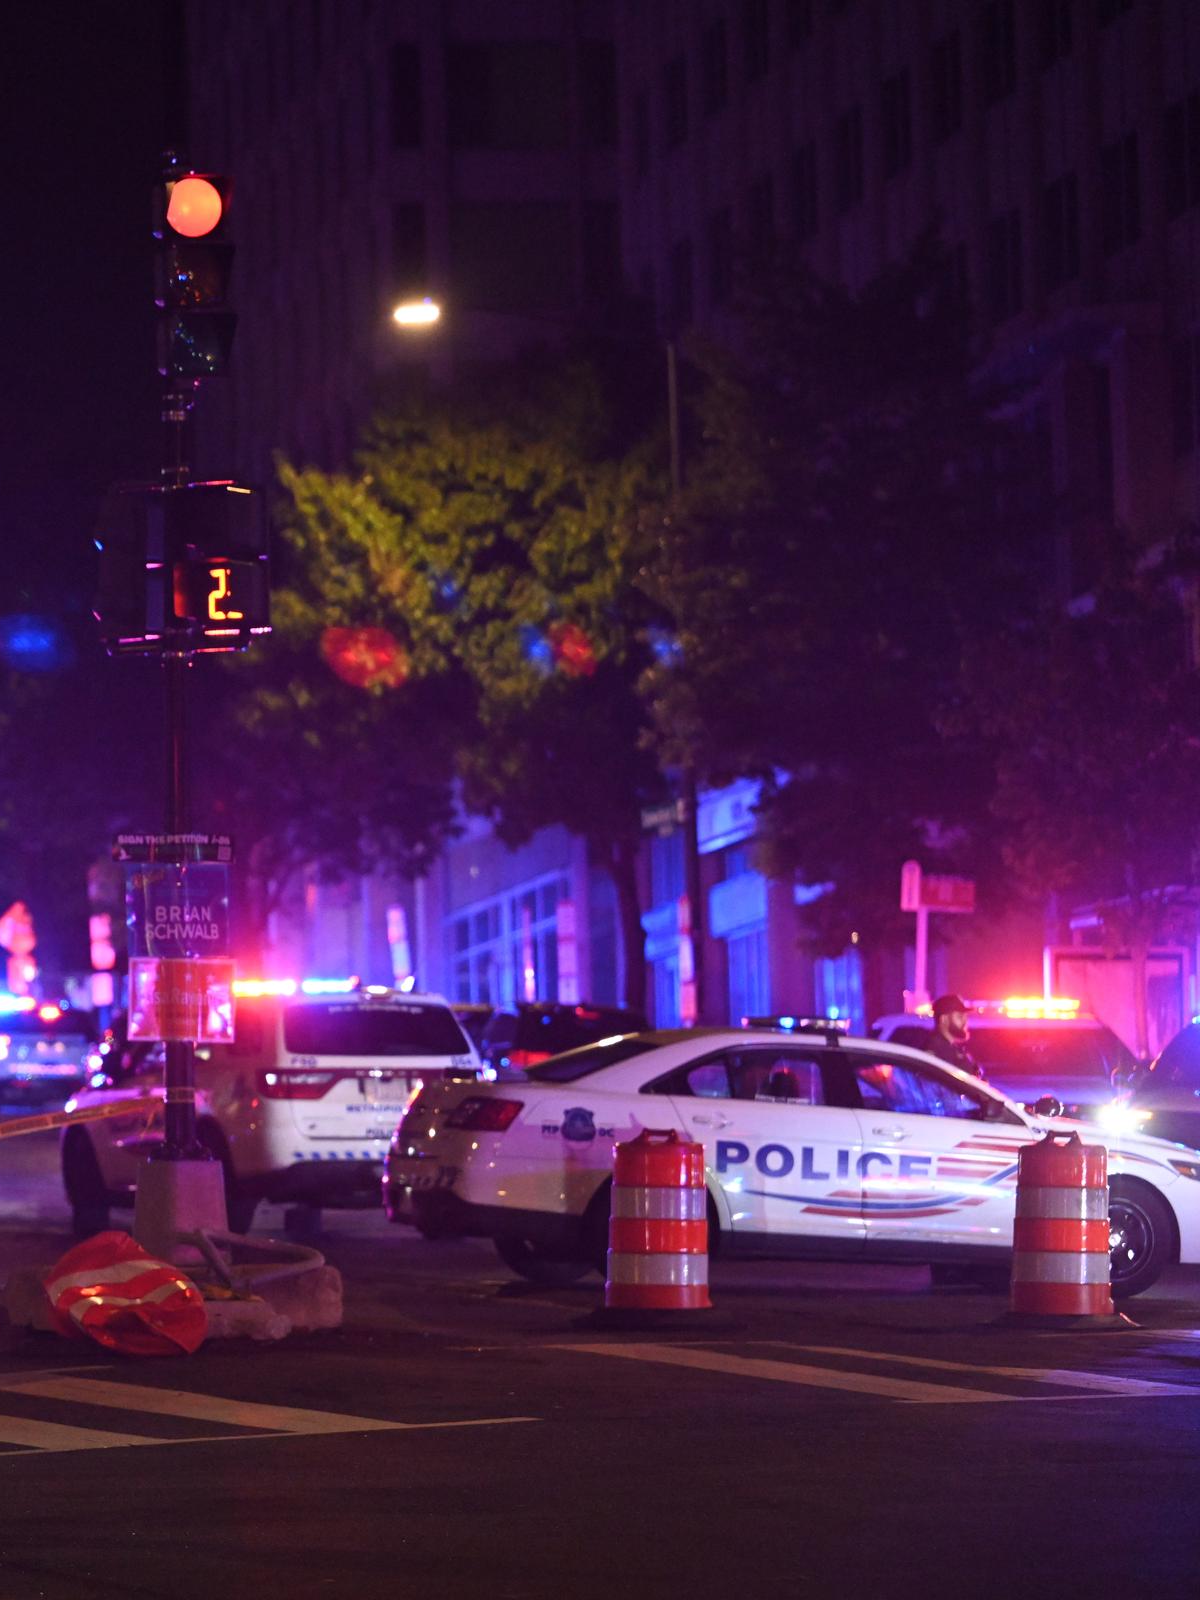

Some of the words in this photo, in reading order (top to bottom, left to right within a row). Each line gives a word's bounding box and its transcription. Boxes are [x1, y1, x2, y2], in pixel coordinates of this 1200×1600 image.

[117, 835, 144, 844] SIGN
[145, 835, 166, 844] THE
[166, 834, 209, 844] PETITION
[155, 905, 212, 921] BRIAN
[145, 923, 219, 939] SCHWALB
[715, 1140, 932, 1180] POLICE
